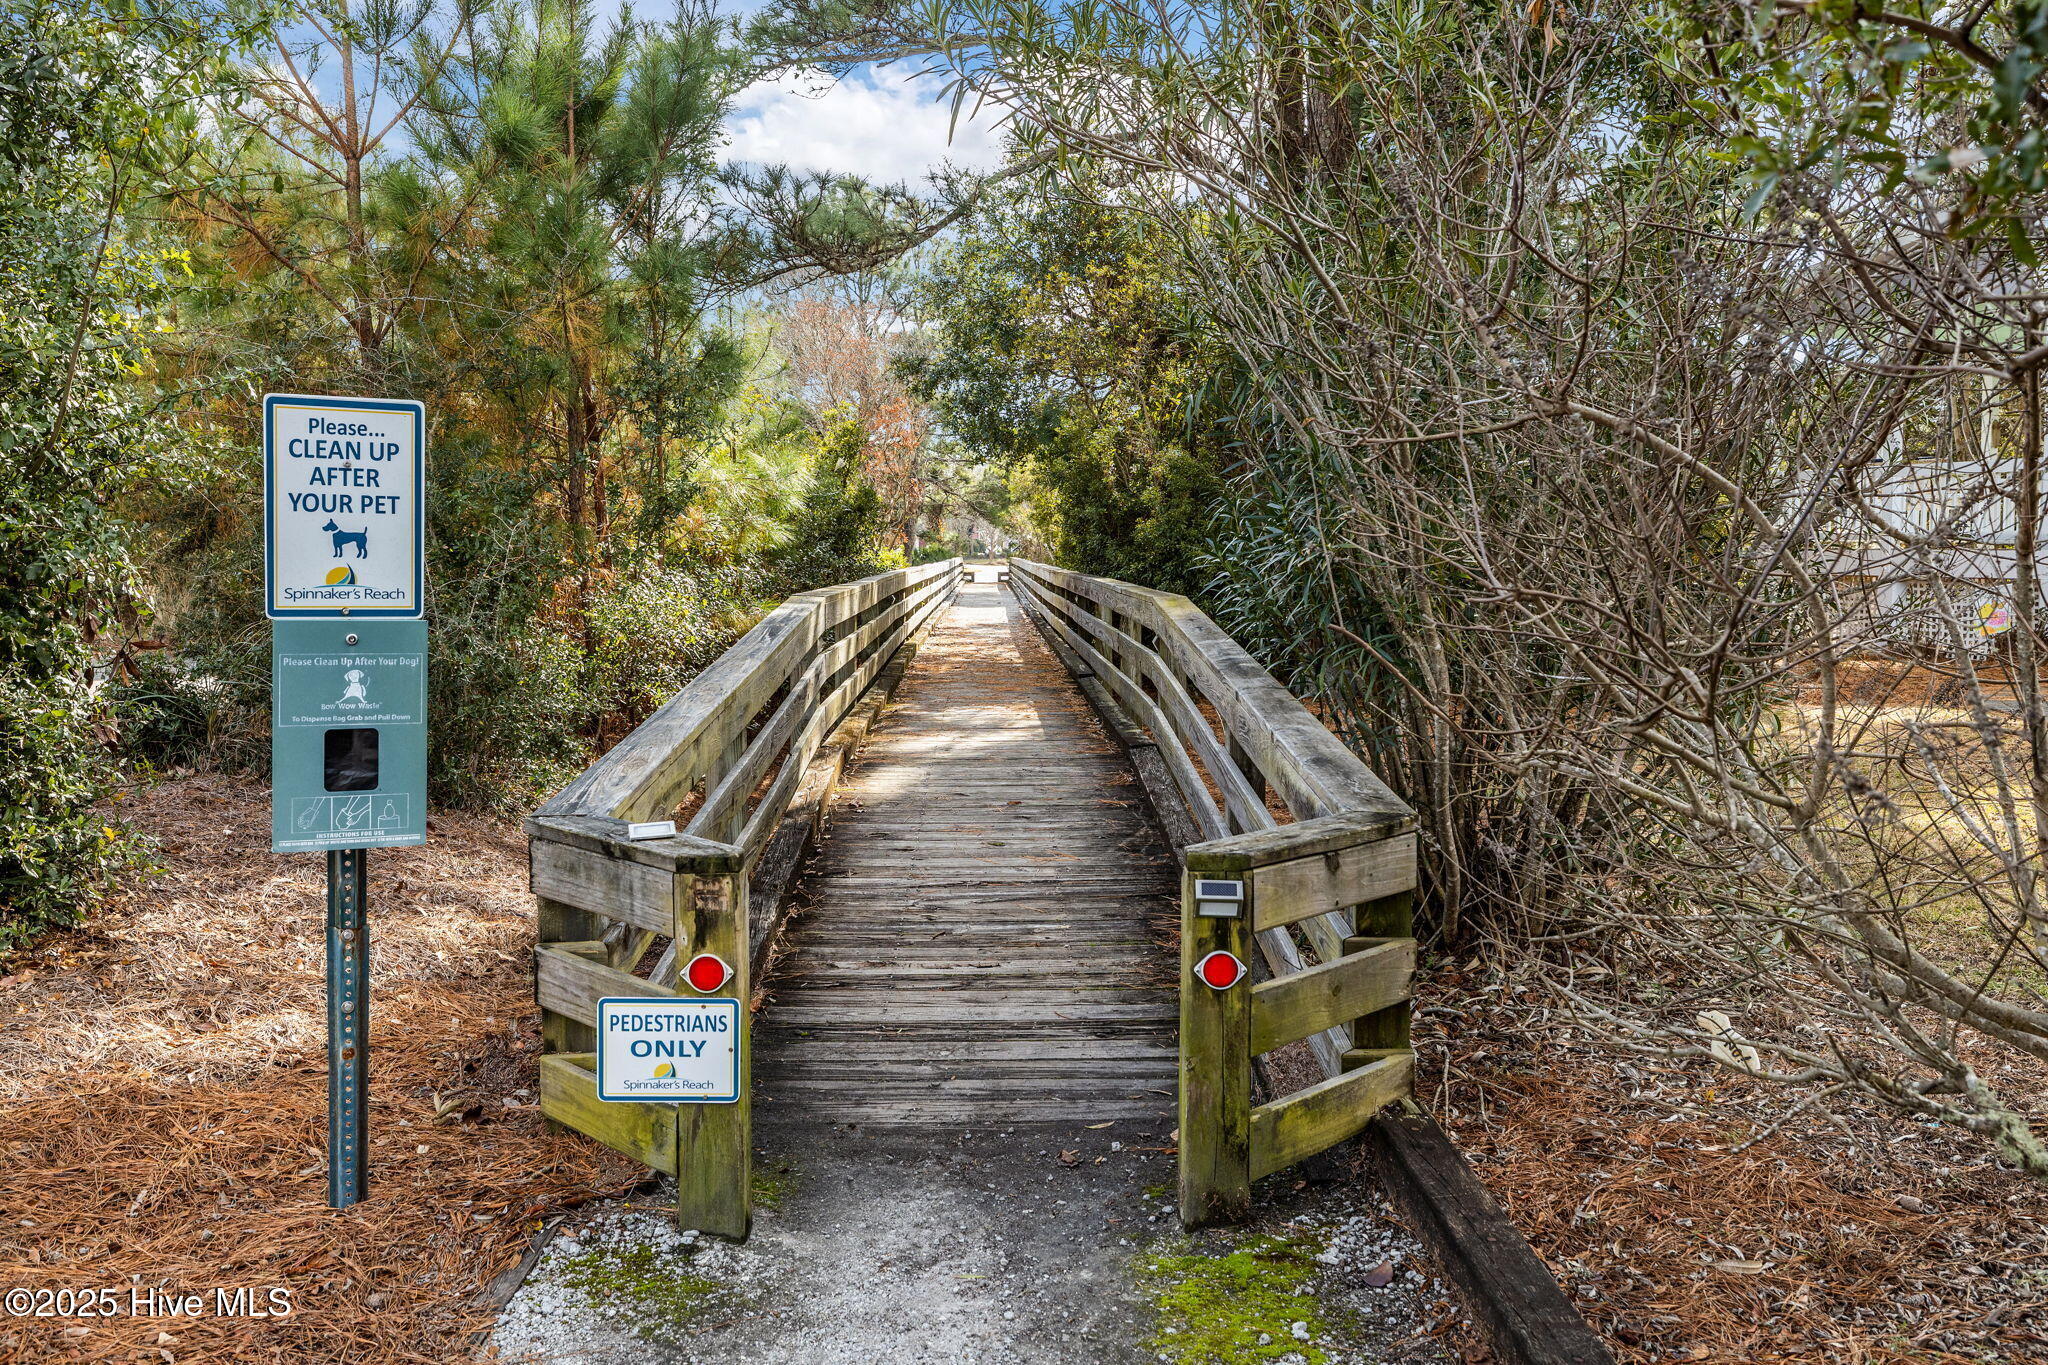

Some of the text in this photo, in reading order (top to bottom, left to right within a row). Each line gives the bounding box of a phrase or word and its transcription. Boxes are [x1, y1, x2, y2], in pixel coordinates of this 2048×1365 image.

[308, 417, 386, 437] Please...
[288, 438, 400, 462] CLEAN UP
[309, 466, 380, 488] AFTER
[288, 492, 400, 515] YOUR PET
[284, 587, 405, 602] Spinnaker's Reach
[283, 656, 419, 668] Please Clean Up After Your Dog!
[333, 715, 346, 723] Bag
[316, 831, 360, 839] INSTRUCTIONS
[609, 1014, 728, 1033] PEDESTRIANS
[630, 1039, 707, 1058] ONLY
[623, 1079, 714, 1092] Spinnaker's Reach
